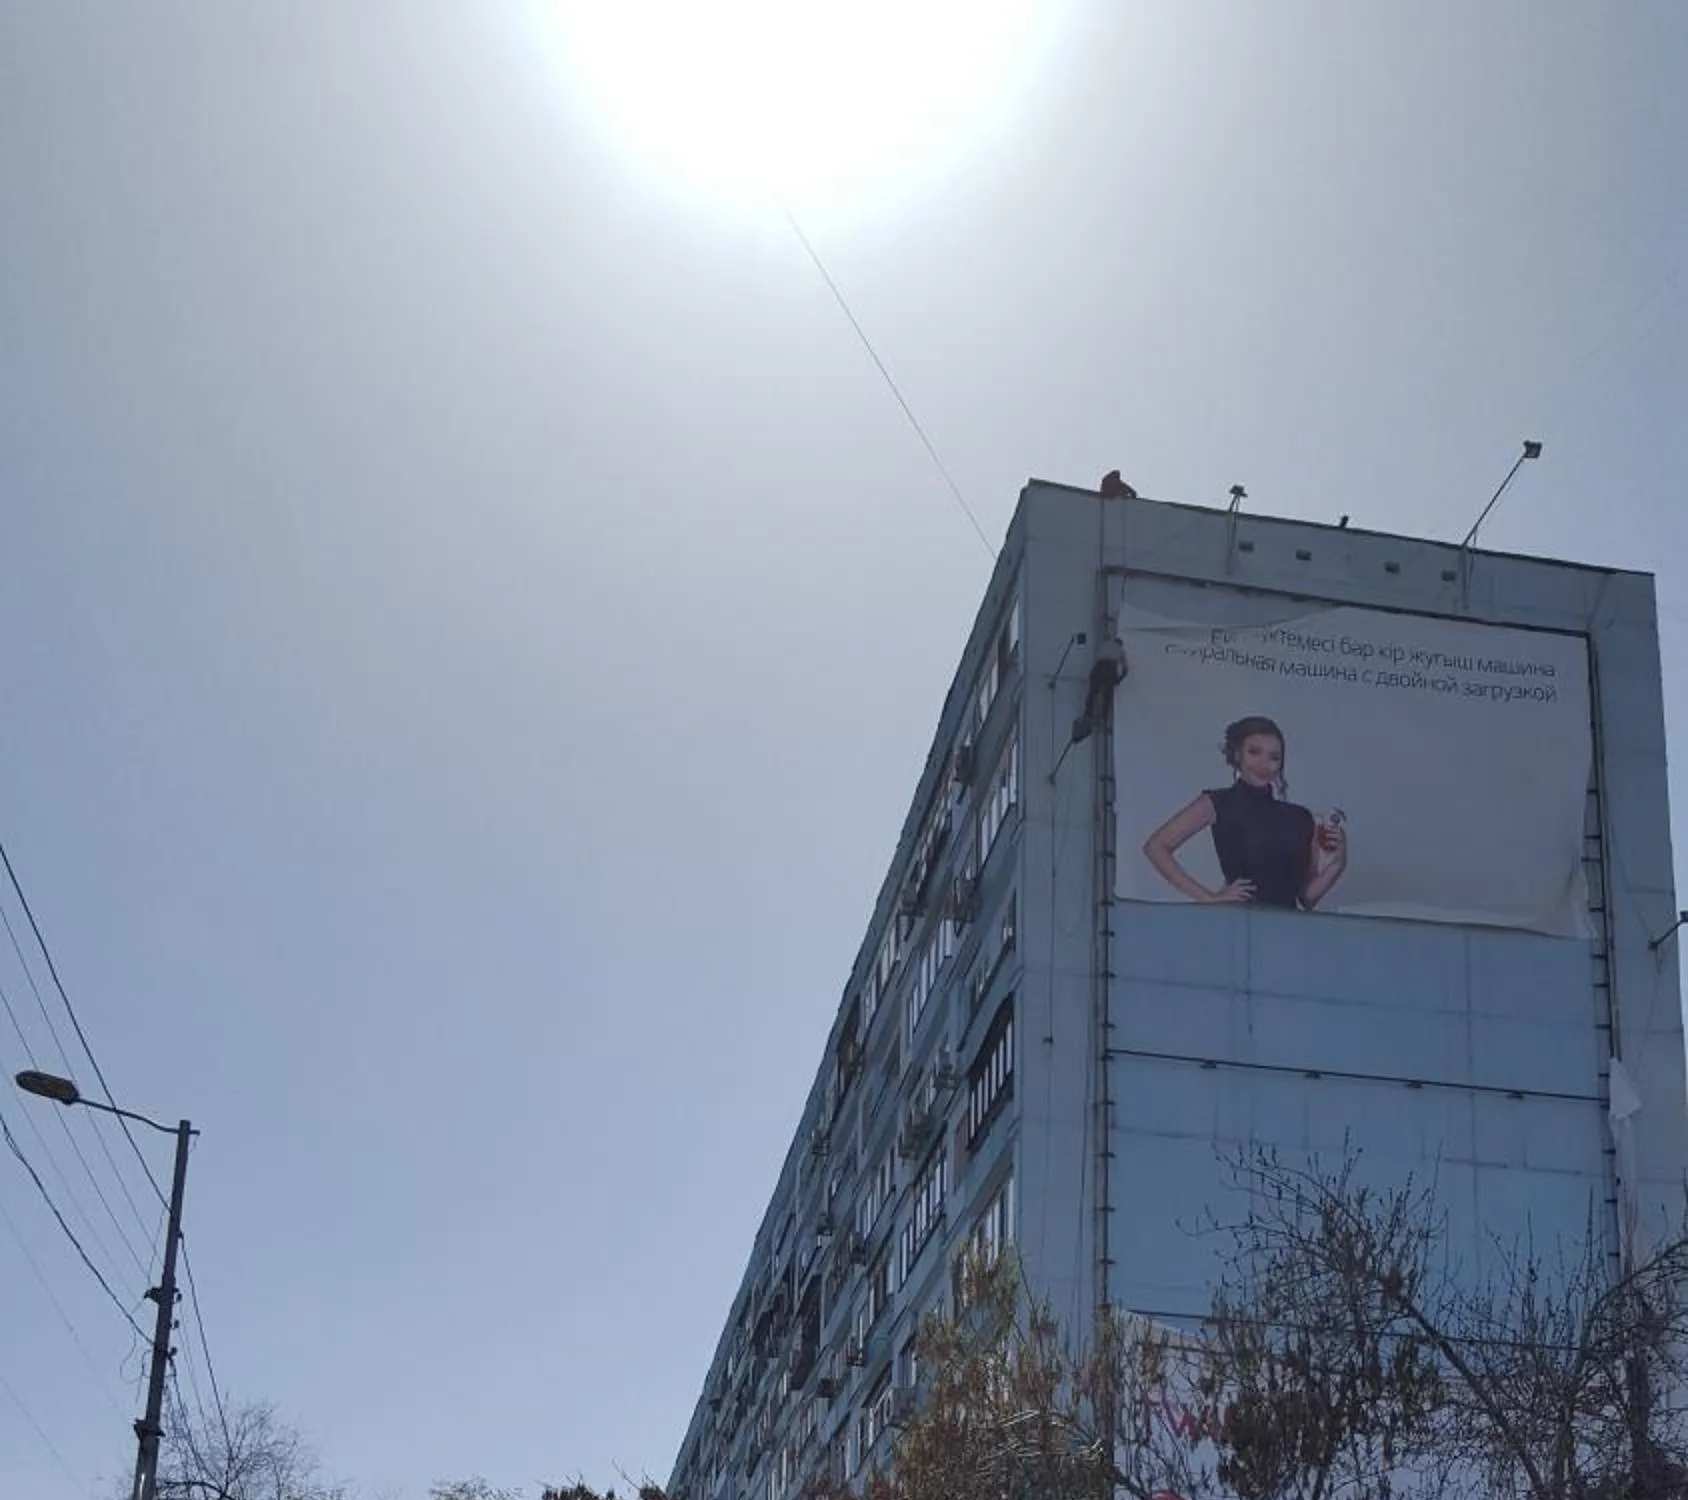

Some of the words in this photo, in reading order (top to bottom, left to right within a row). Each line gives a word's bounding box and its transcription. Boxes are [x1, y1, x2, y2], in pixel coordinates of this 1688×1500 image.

[1279, 659, 1357, 682] машина
[1375, 669, 1458, 694] двойной
[1463, 680, 1557, 704] загрузкой
[1477, 656, 1556, 679] машина
